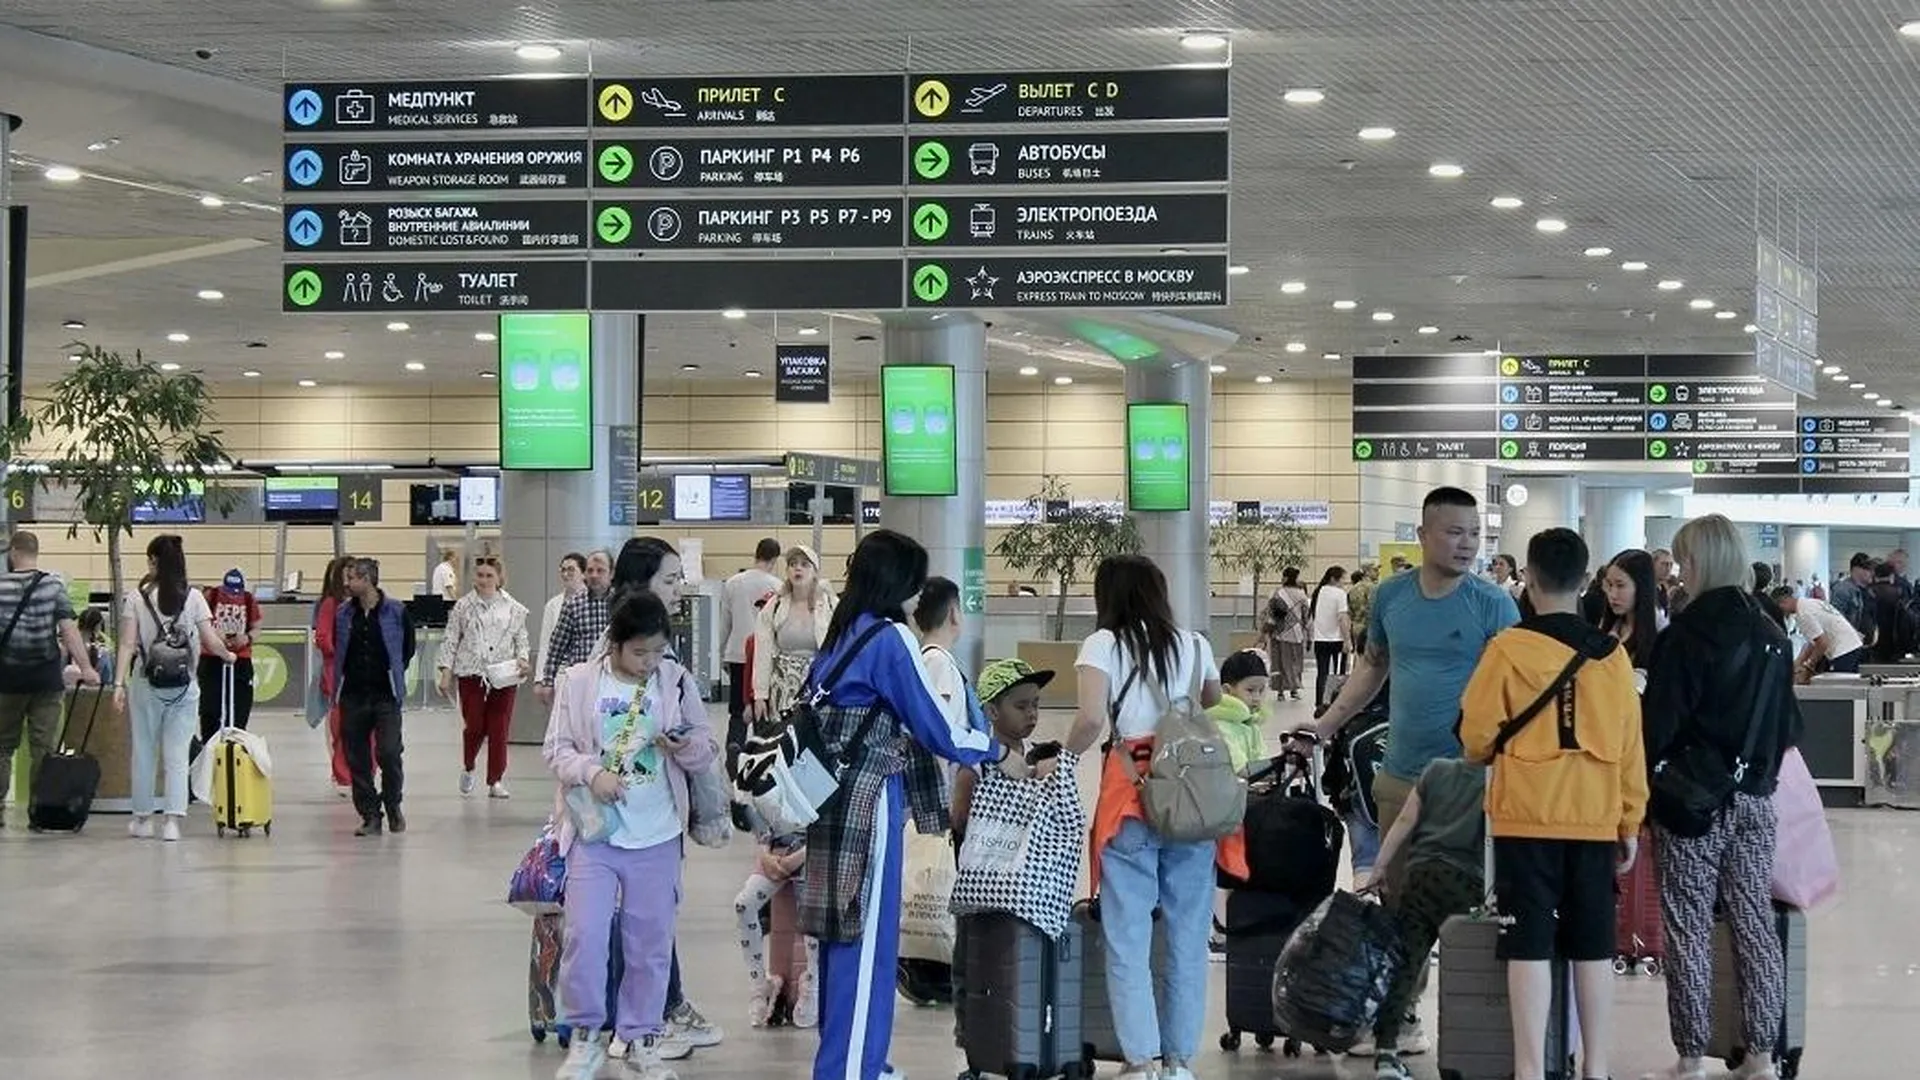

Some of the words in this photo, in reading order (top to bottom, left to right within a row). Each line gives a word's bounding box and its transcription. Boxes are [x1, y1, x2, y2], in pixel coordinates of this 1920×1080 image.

[699, 88, 761, 102] ПРИЛЕТ
[1020, 84, 1074, 98] ВЫЛЕТ
[1107, 83, 1118, 97] D
[389, 92, 475, 108] МЕДПУНКТ
[697, 110, 744, 120] ARRIVALS
[1018, 106, 1083, 116] DEPARTURES
[389, 115, 431, 125] MEDICAL
[433, 114, 478, 124] SERVICES
[389, 153, 452, 165] КОМНАТА
[455, 152, 523, 164] ХРАНЕНИЯ
[527, 151, 582, 164] ОРУЖИЯ
[701, 149, 775, 164] ПАРКИНГ
[784, 149, 801, 163] P1
[812, 148, 831, 162] P4
[841, 148, 860, 162] P6
[1018, 145, 1105, 160] АВТОБУСЫ
[701, 171, 743, 182] PARKING
[1019, 168, 1050, 178] BUSES
[388, 176, 434, 185] WEAPON
[433, 174, 476, 185] STORAGE
[479, 174, 508, 184] ROOM
[388, 207, 432, 219] РОЗЫСК
[435, 207, 478, 218] БАГАЖА
[699, 210, 773, 224] ПАРКИНГ
[782, 210, 800, 224] P3
[810, 209, 828, 224] P5
[1018, 206, 1157, 223] ЭЛЕКТРОПОЕЗДА
[389, 221, 458, 232] ВНУТРЕННИЕ
[462, 220, 529, 231] АВИАЛИНИИ
[389, 235, 441, 245] DOMESTIC
[440, 235, 509, 245] LOST&FOUND
[699, 233, 741, 243] PARKING
[1017, 229, 1054, 239] TRAINS
[459, 273, 518, 287] ТУАЛЕТ
[1017, 270, 1120, 283] АЭРОЭКСПРЕСС
[1125, 270, 1133, 283] В
[1138, 270, 1194, 283] МОСКВУ
[458, 295, 491, 305] TOILET
[1017, 292, 1057, 301] EXPRESS
[1059, 292, 1085, 300] TRAIN
[1089, 291, 1104, 301] TO
[1103, 291, 1145, 300] MOSCOW
[780, 357, 827, 366] УПАКОВКА
[786, 367, 821, 375] БАГАЖА
[350, 491, 372, 509] 14
[639, 490, 663, 508] 12
